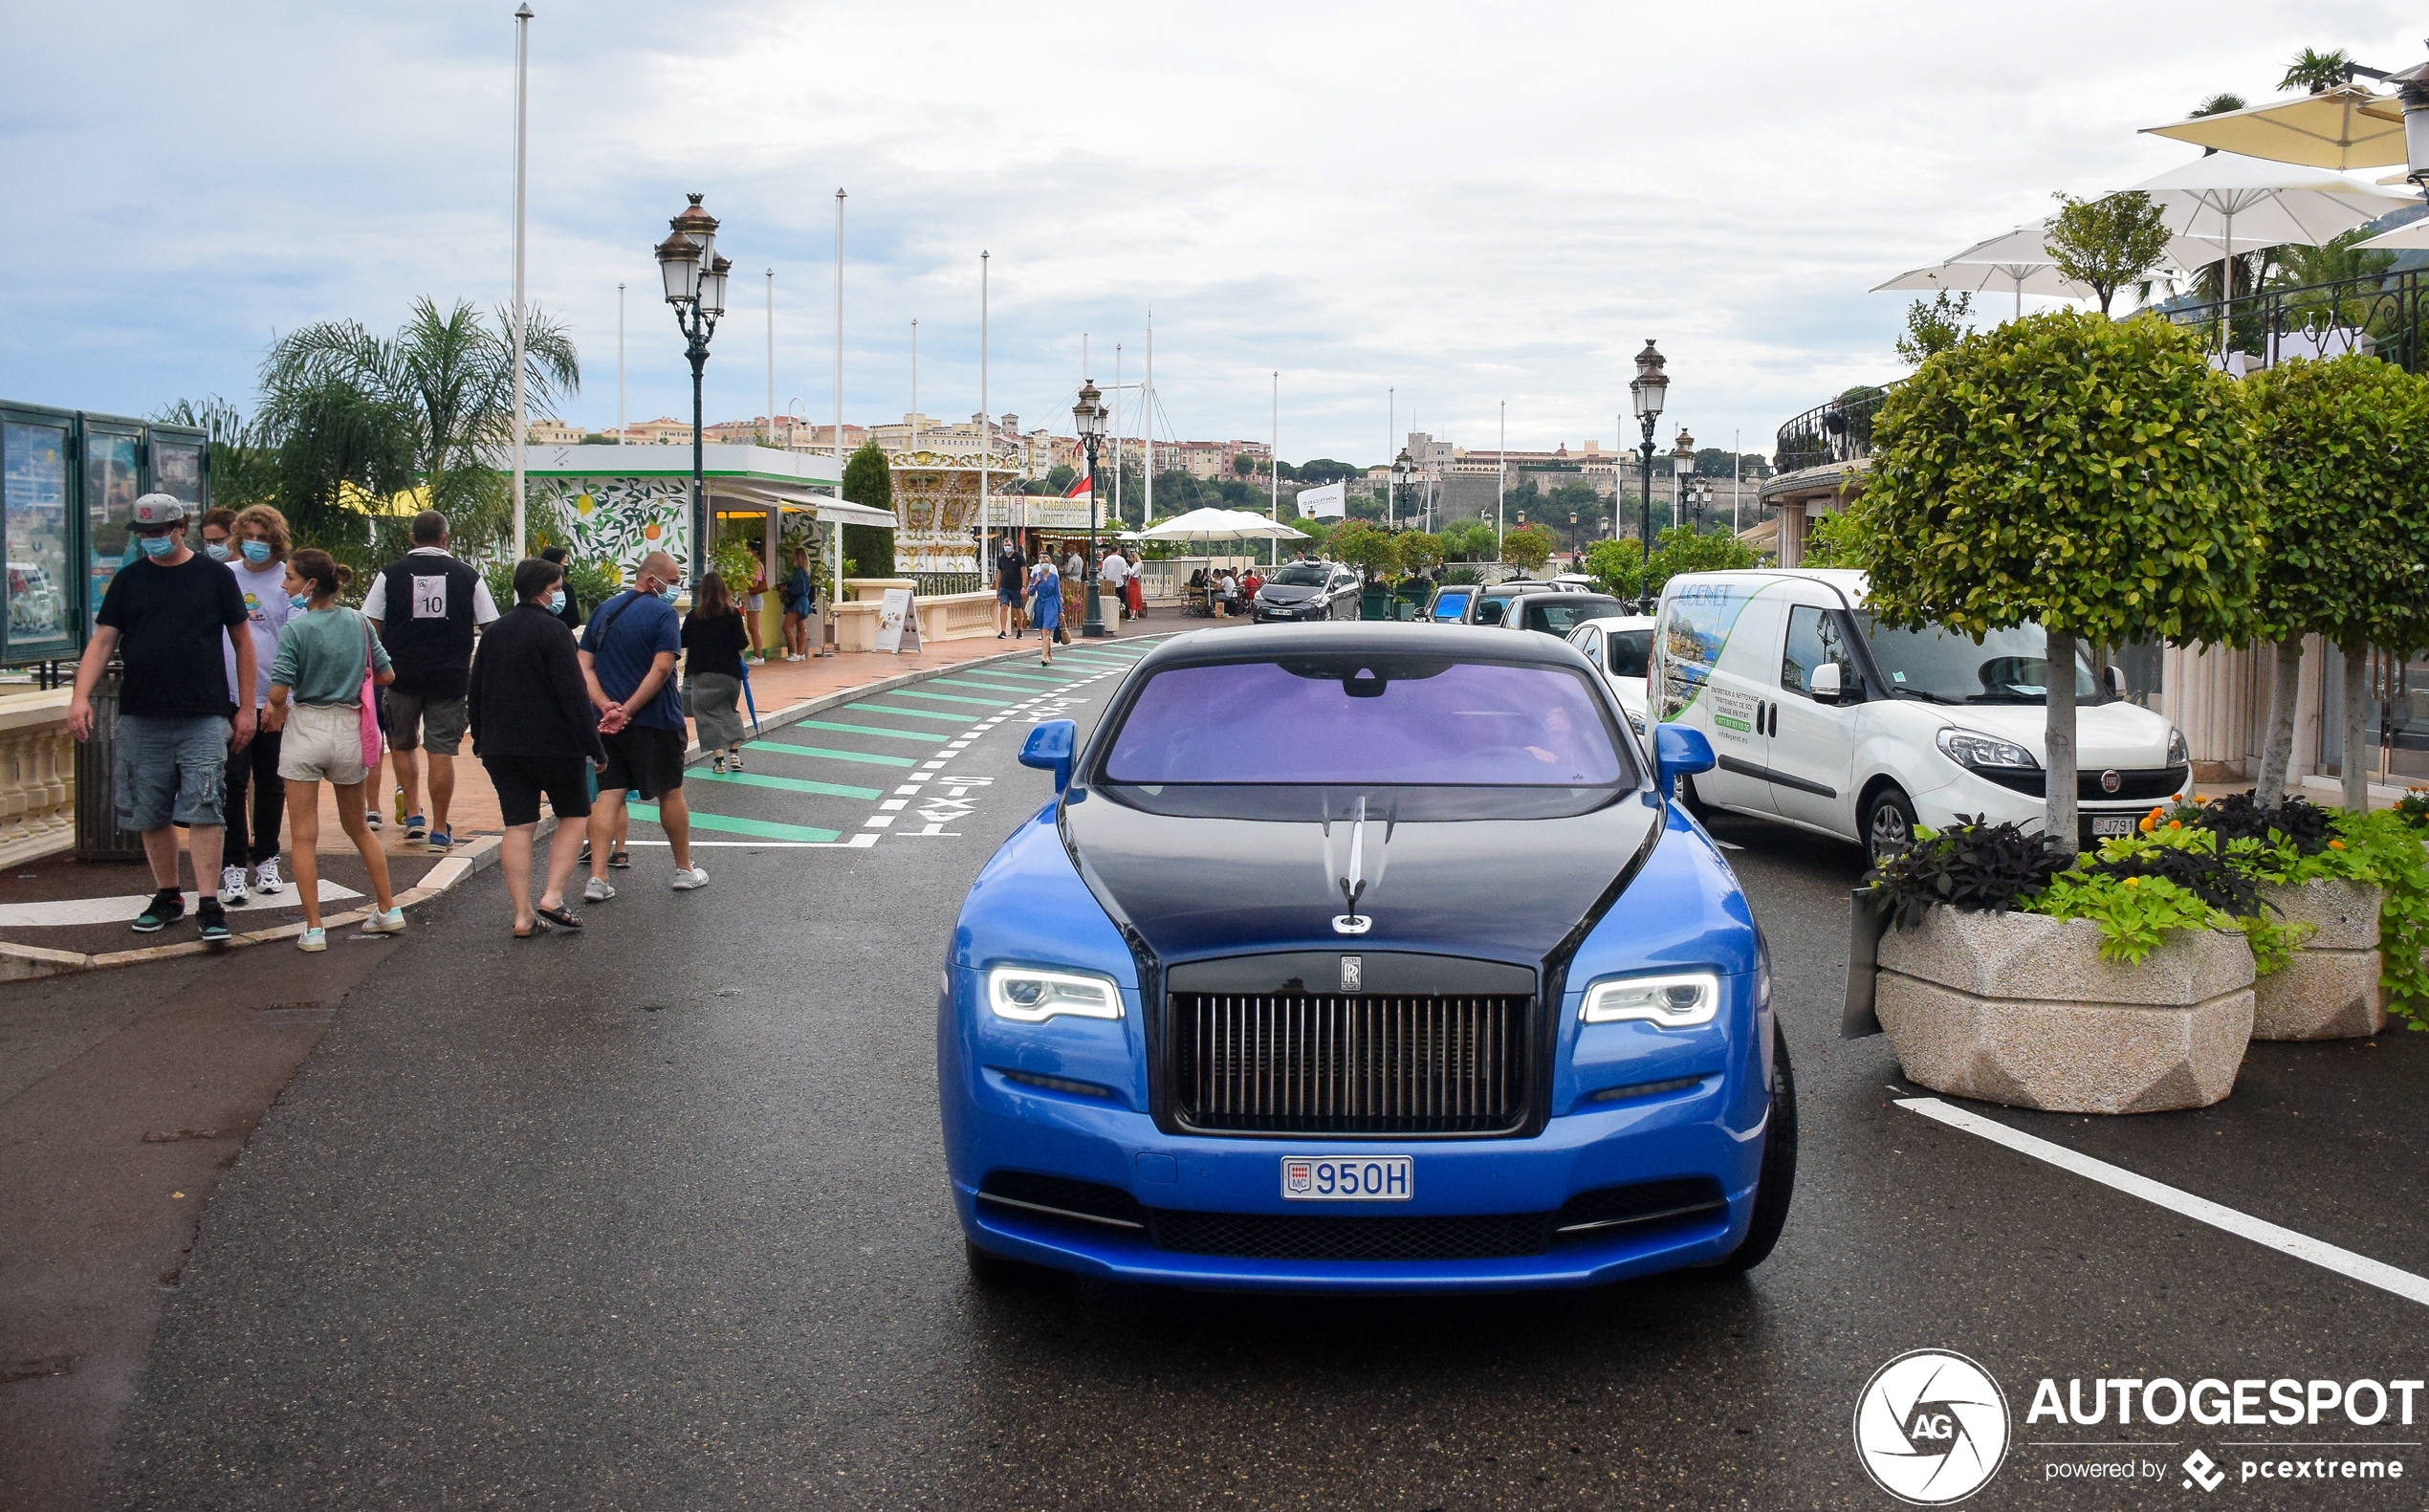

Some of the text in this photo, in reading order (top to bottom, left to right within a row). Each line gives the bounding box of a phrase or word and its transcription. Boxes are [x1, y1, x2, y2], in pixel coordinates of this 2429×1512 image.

[1043, 501, 1087, 512] CARROUSEL
[1039, 514, 1090, 525] MONTE CARLO
[1677, 584, 1734, 606] AGENET
[423, 597, 442, 613] 10
[1711, 687, 1731, 696] ENTRETIEN
[1736, 692, 1759, 703] NETTOYAGE
[1715, 696, 1739, 707] TRAITEMENT
[1718, 706, 1732, 715] REMISE
[2106, 777, 2117, 787] FIAT
[2105, 820, 2133, 833] J791
[1292, 1162, 1406, 1194] MC 950H
